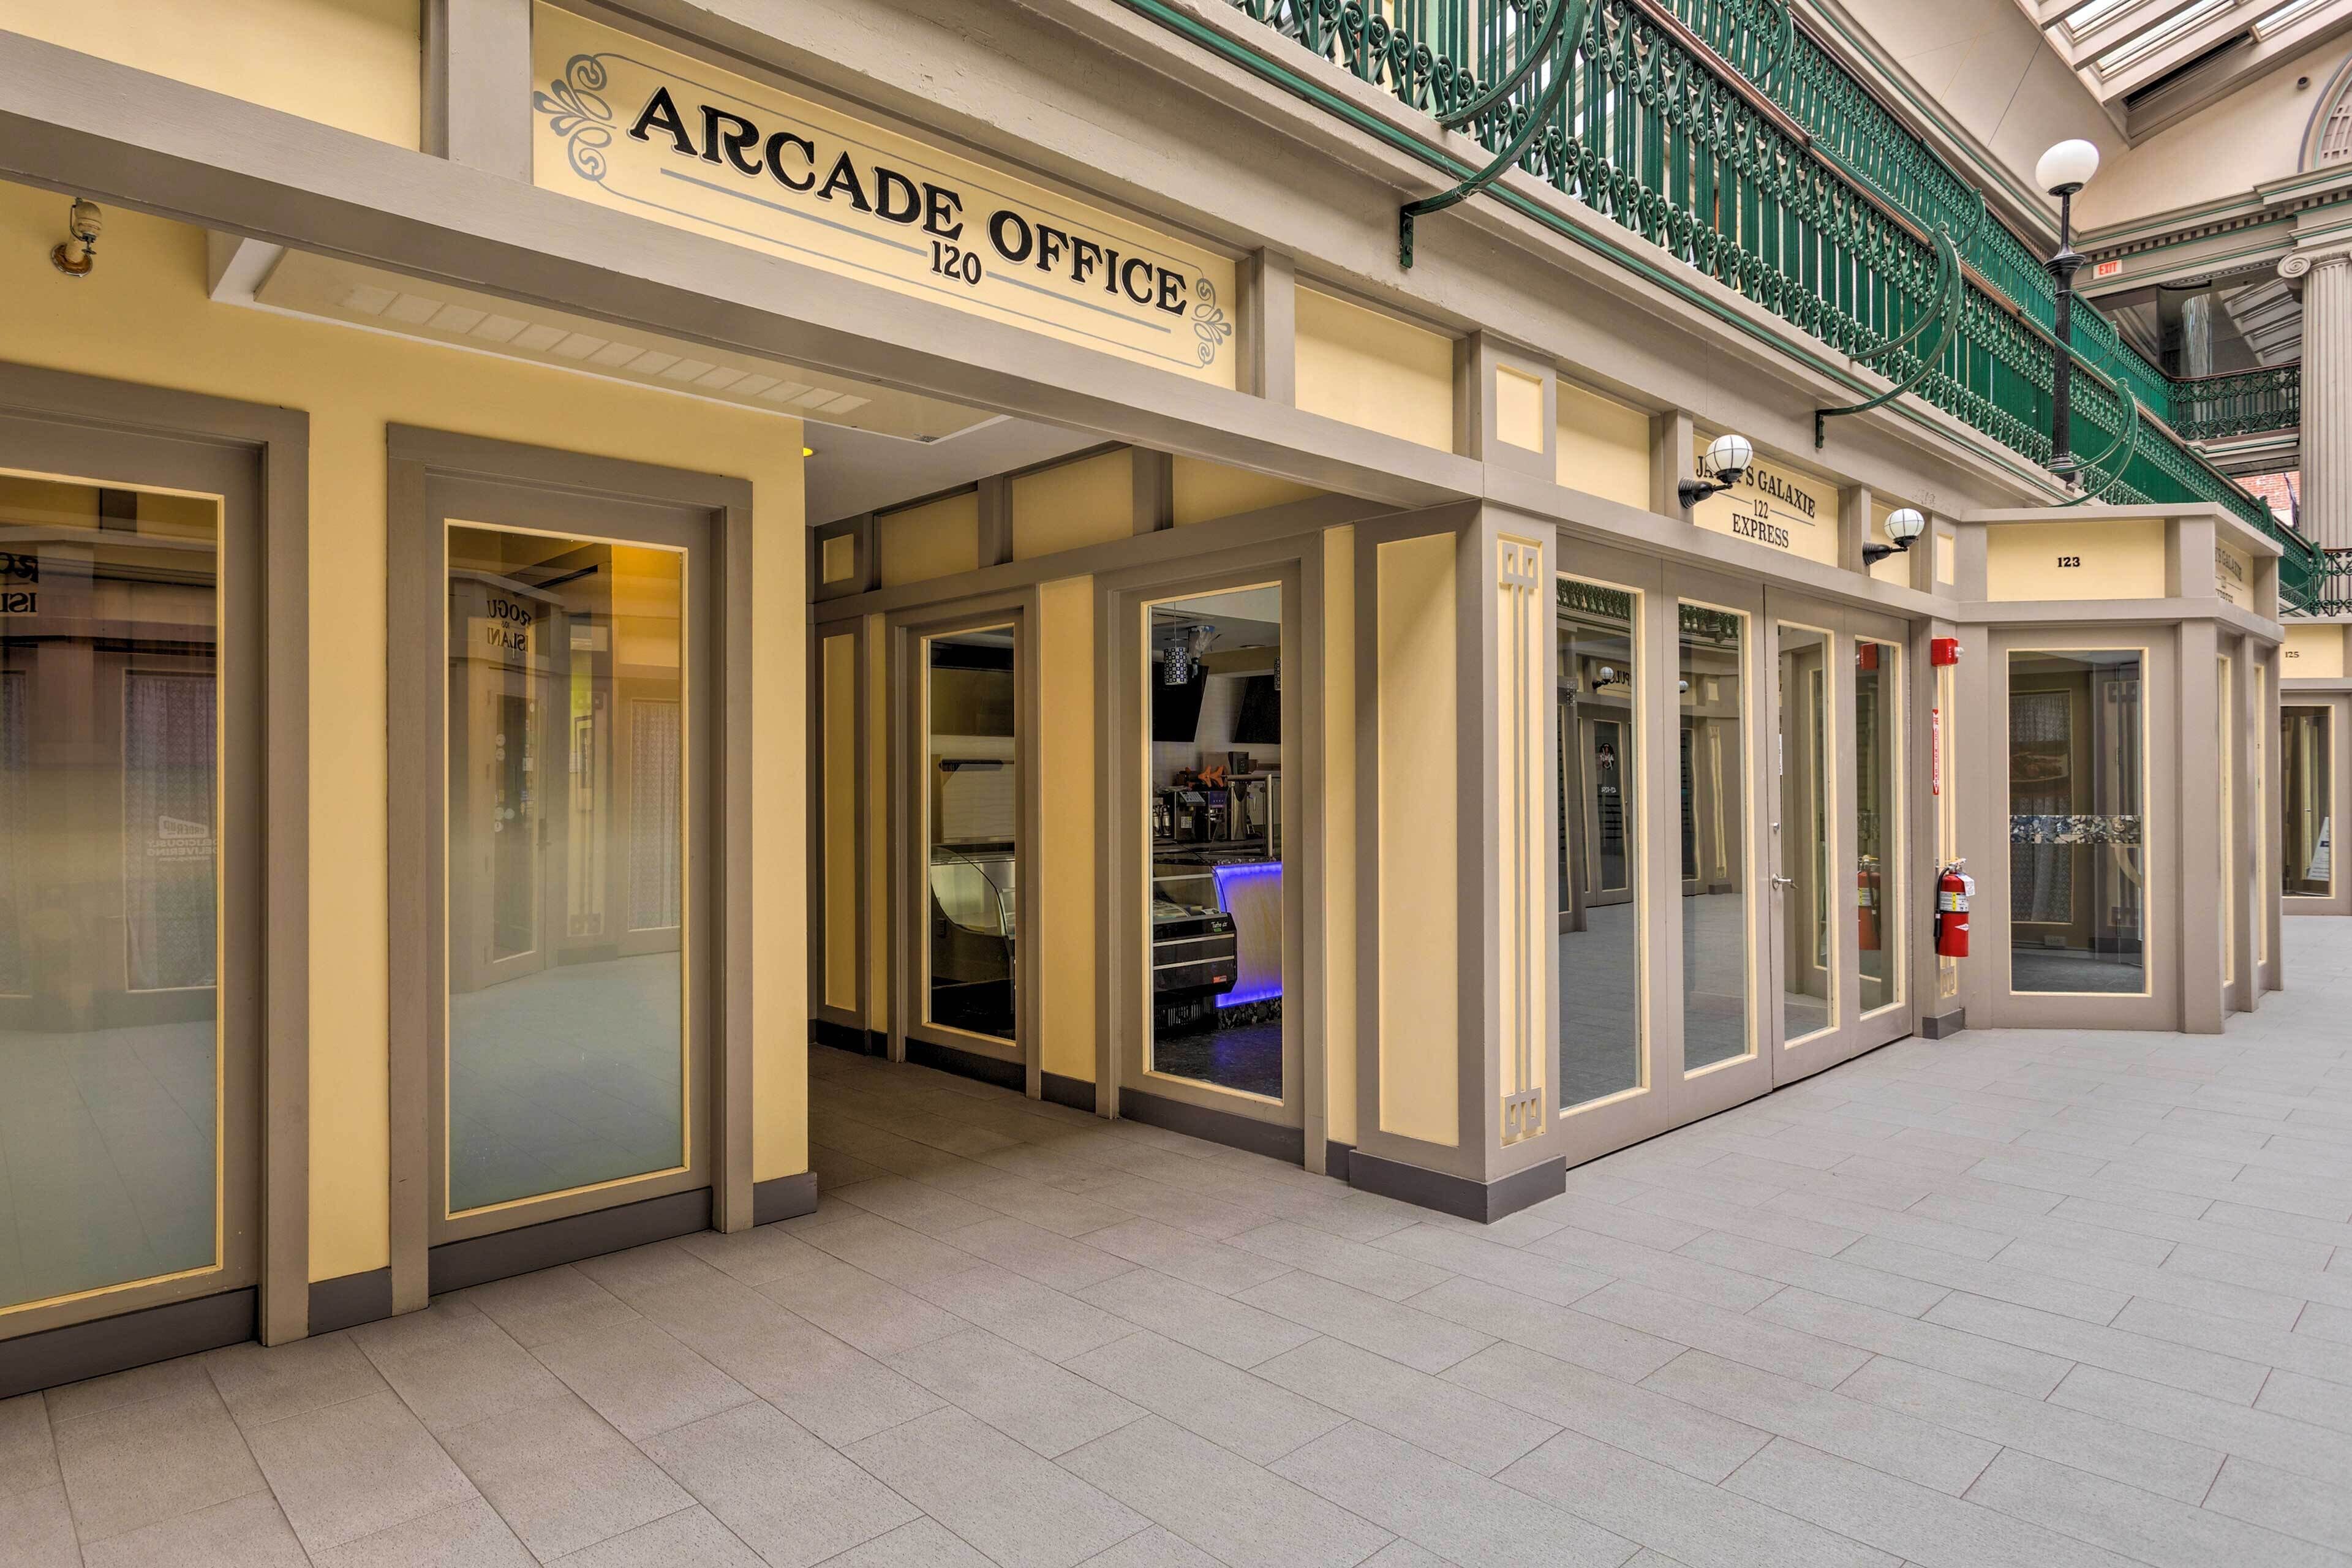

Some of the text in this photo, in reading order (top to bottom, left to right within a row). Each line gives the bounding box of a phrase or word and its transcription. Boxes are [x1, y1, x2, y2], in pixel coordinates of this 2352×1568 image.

[627, 86, 1187, 317] ARCADE OFFICE
[930, 240, 982, 286] 120
[2099, 262, 2117, 275] EXIT
[1754, 499, 1769, 519] 122
[1758, 470, 1816, 519] GALAXIE
[1732, 513, 1789, 548] EXPRESS
[2057, 556, 2081, 568] 123
